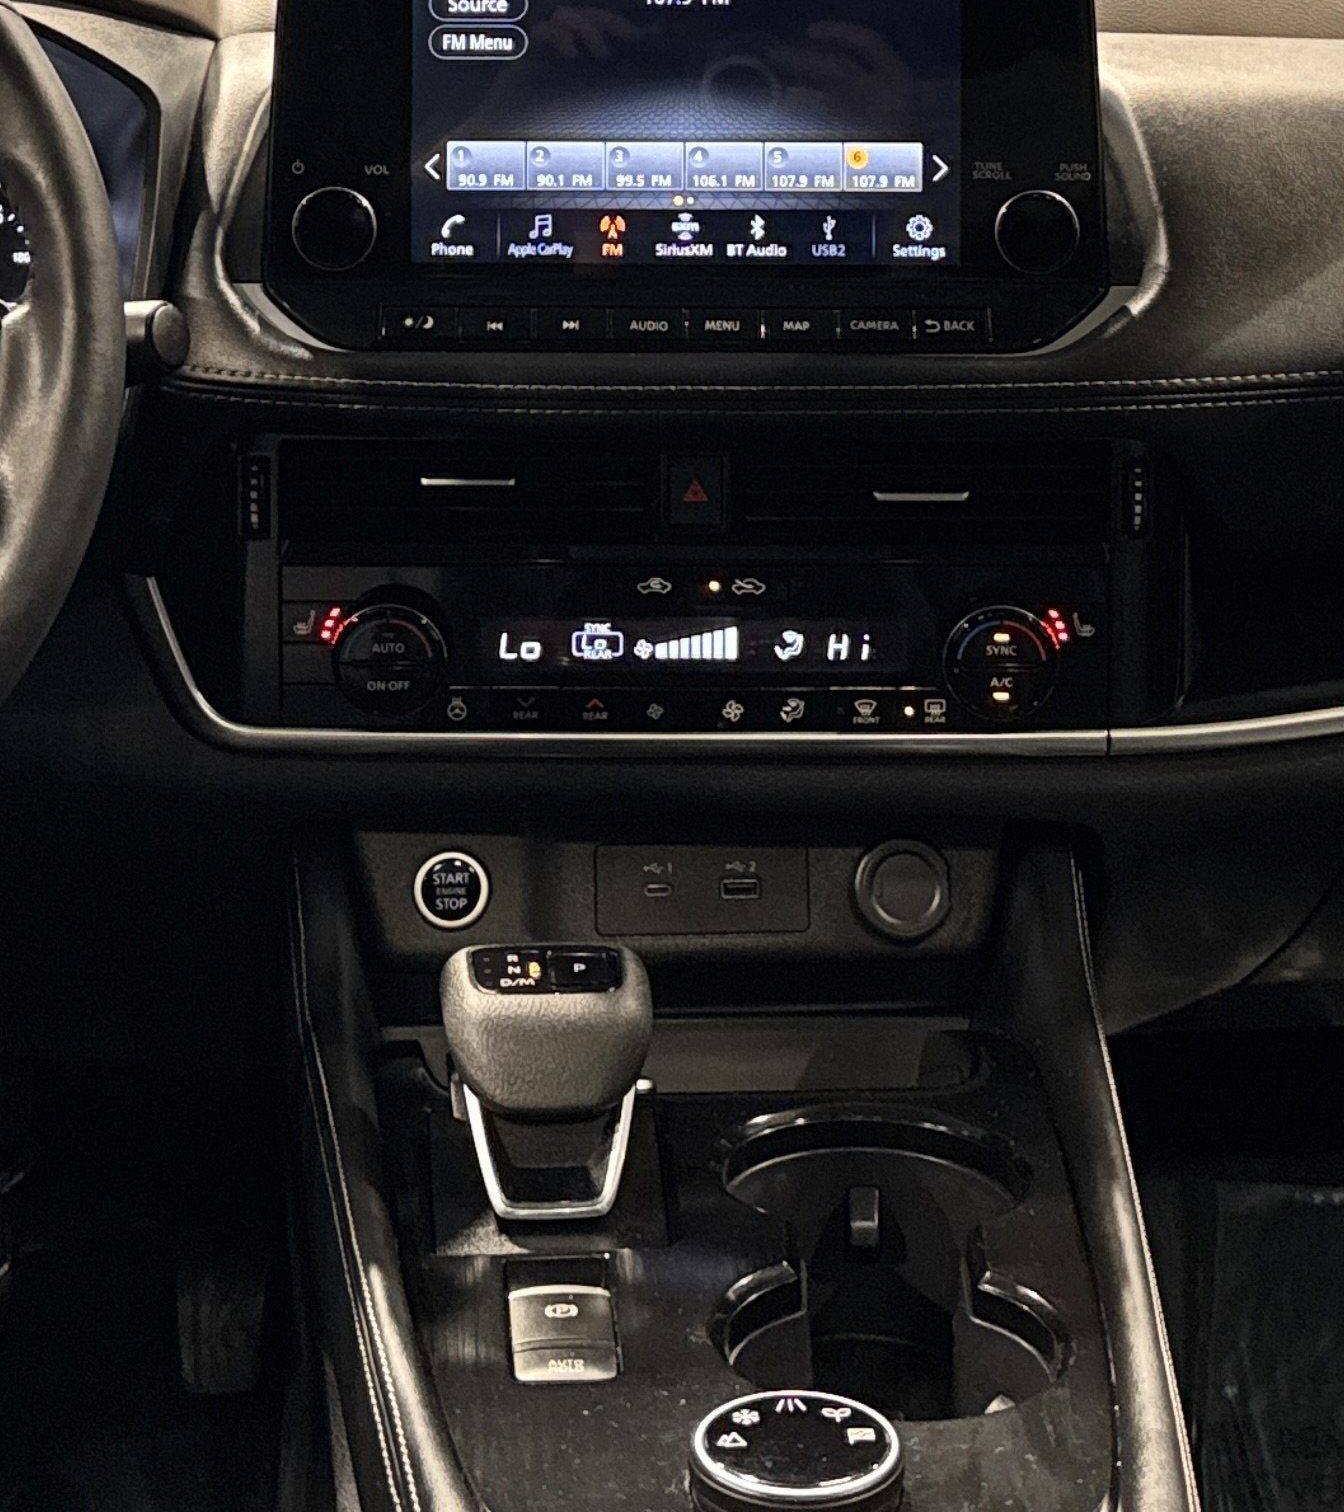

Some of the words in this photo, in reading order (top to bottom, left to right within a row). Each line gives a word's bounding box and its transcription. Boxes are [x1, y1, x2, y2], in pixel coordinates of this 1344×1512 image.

[441, 33, 467, 51] FM
[468, 33, 514, 51] Menu
[456, 149, 466, 162] 1
[534, 149, 546, 162] 2
[613, 149, 625, 163] 3
[692, 150, 704, 163] 4
[772, 150, 783, 164] 5
[852, 150, 863, 163] 6
[363, 164, 390, 176] VOL
[1058, 162, 1088, 172] PUSH
[458, 173, 488, 187] 90.9
[493, 173, 514, 187] FM
[536, 173, 565, 187] 90.1
[571, 173, 593, 187] FM
[615, 173, 646, 187] 99.5
[650, 174, 672, 187] FM
[692, 174, 728, 188] 106.1
[734, 174, 756, 188] FM
[771, 174, 809, 188] 107.9
[813, 174, 835, 188] FM
[851, 174, 889, 188] 107.9
[894, 174, 916, 188] FM
[1053, 172, 1093, 182] SOUND
[430, 241, 475, 257] Phone
[506, 241, 537, 259] Apple
[536, 241, 575, 259] CarPlay
[600, 242, 624, 257] FM
[655, 242, 714, 258] SiriusXM
[725, 243, 745, 258] BT
[744, 243, 789, 258] Audio
[810, 243, 847, 258] USB2
[891, 243, 948, 262] Settings
[628, 319, 670, 332] AUDIO
[703, 319, 742, 332] MENU
[781, 320, 811, 332] MAP
[849, 319, 901, 332] CAMERA
[942, 320, 976, 332] BACK
[371, 642, 406, 654] AUTO
[497, 631, 543, 661] Lo
[825, 632, 871, 661] Hi
[985, 644, 1018, 657] SYNC
[989, 676, 1014, 690] A/C
[512, 710, 539, 720] REAR
[582, 710, 609, 721] REAR
[852, 715, 881, 725] FRONT
[432, 872, 471, 886] START
[435, 897, 469, 911] STOP
[506, 953, 520, 963] R
[507, 965, 522, 975] N
[572, 962, 587, 974] P
[499, 977, 536, 988] D/M
